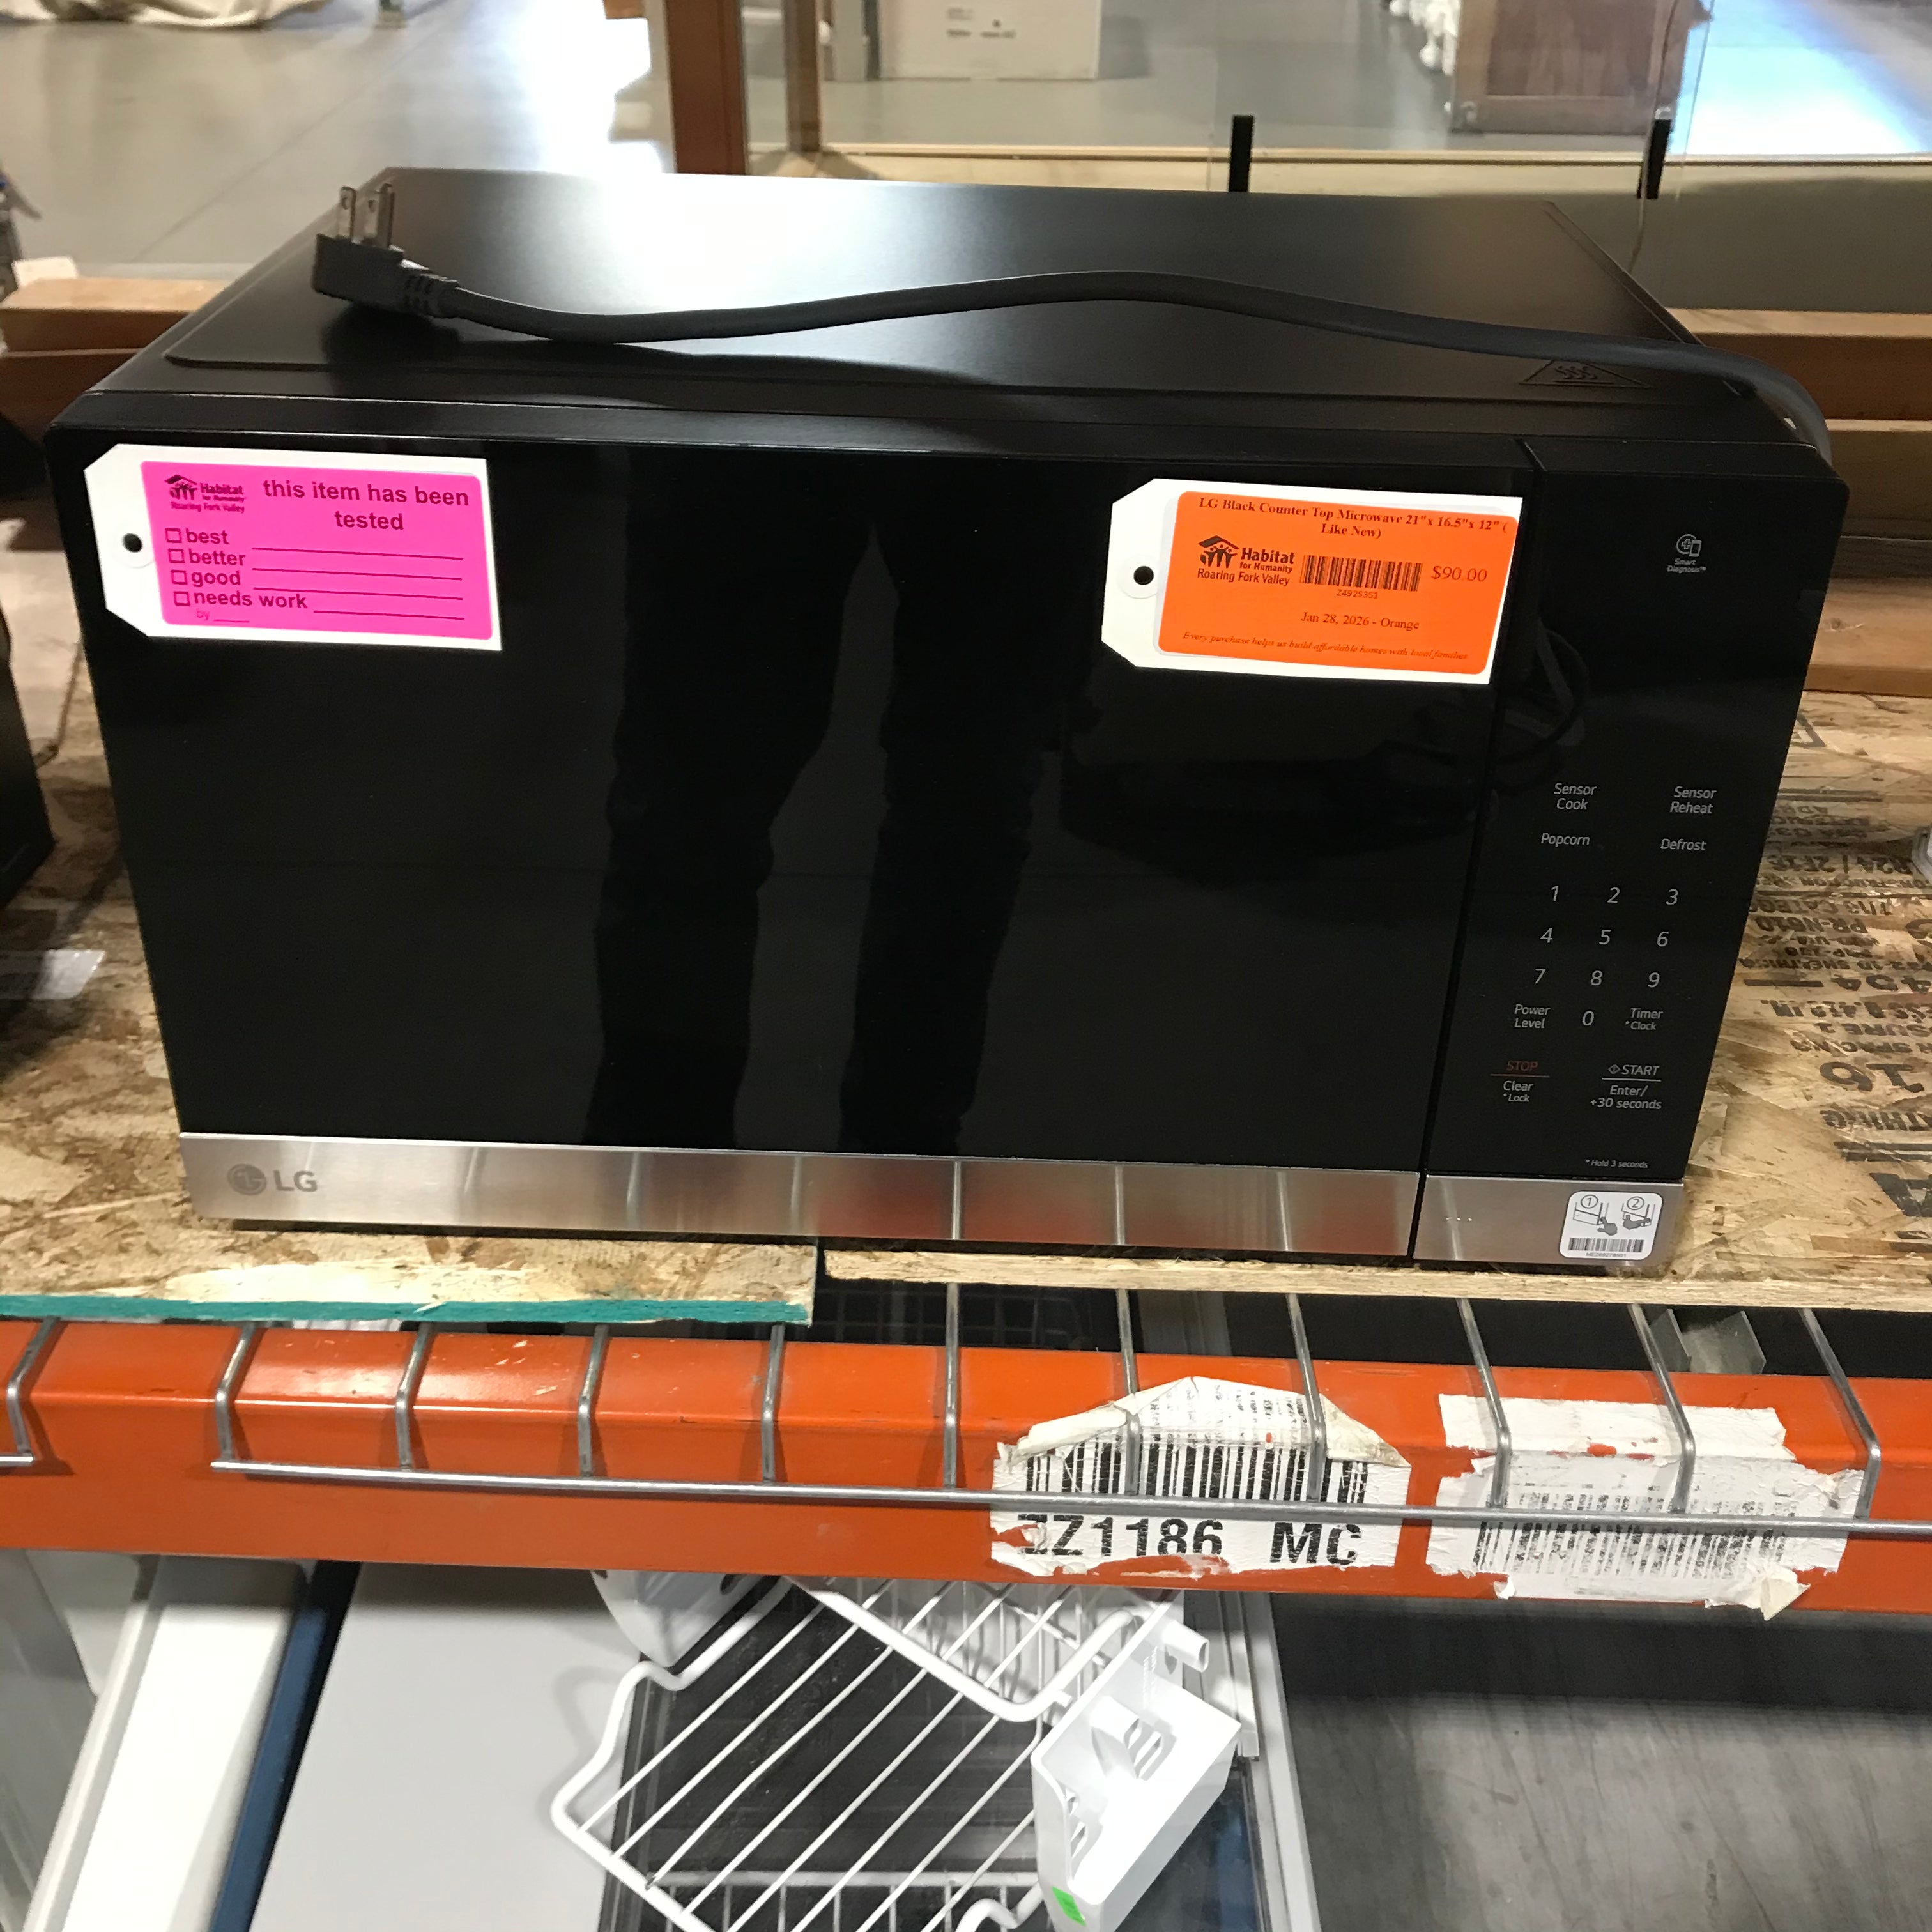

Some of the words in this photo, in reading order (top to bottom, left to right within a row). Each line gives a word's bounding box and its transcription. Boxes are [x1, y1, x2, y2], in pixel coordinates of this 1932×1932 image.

[263, 480, 305, 498] this
[312, 482, 360, 500] item
[367, 484, 407, 503] has
[415, 486, 469, 506] been
[1199, 498, 1218, 509] LG
[1223, 500, 1256, 512] Black
[1260, 502, 1308, 516] Counter
[1312, 507, 1334, 521] Top
[1338, 509, 1403, 524] Microwave
[335, 511, 404, 530] tested
[185, 528, 229, 545] best
[1321, 523, 1347, 535] Like
[1351, 525, 1381, 539] New)
[189, 548, 246, 566] better
[1241, 547, 1296, 565] Habitat
[1240, 561, 1252, 569] for
[1254, 564, 1292, 574] Humanity
[1431, 565, 1488, 583] $90.00
[192, 570, 241, 588] good
[1197, 568, 1235, 583] Roaring
[1238, 571, 1259, 583] Fork
[1262, 574, 1290, 587] Valley
[194, 590, 253, 606] needs
[259, 594, 308, 609] work
[197, 609, 210, 621] by
[1301, 611, 1319, 623] Jan
[1322, 613, 1338, 625] 28,
[1342, 615, 1370, 626] 2026
[1380, 617, 1420, 631] Orange
[1183, 631, 1208, 643] Every
[1210, 635, 1249, 645] purchase
[1252, 637, 1275, 648] helps
[1289, 640, 1312, 649] build
[1313, 642, 1358, 652] affordable
[1360, 645, 1387, 654] homes
[1554, 783, 1597, 795] Sensor
[1673, 786, 1717, 799] Sensor
[1556, 798, 1589, 810] Cook
[1669, 801, 1714, 814] Reheat
[1540, 832, 1591, 847] Popcorn
[1660, 838, 1707, 851] Defrost
[1551, 885, 1560, 901] 1
[1607, 887, 1621, 903] 2
[1666, 889, 1679, 905] 3
[1540, 928, 1553, 943] 4
[1598, 929, 1612, 945] 5
[1657, 931, 1669, 947] 6
[1535, 968, 1546, 984] 7
[1590, 970, 1603, 986] 8
[1648, 972, 1660, 988] 9
[1514, 1004, 1551, 1016] Power
[1630, 1008, 1664, 1019] Timer
[1514, 1017, 1546, 1029] Level
[1582, 1011, 1595, 1026] 0
[1840, 1023, 1932, 1038] SURE
[1506, 1061, 1538, 1071] STOP
[1621, 1064, 1660, 1075] START
[1819, 1061, 1924, 1093] 16
[1503, 1080, 1533, 1091] Clear
[1610, 1085, 1648, 1096] Enter/
[1590, 1098, 1614, 1108] +30
[1616, 1098, 1662, 1110] seconds
[1591, 1159, 1609, 1167] Hold
[1618, 1160, 1649, 1169] seconds
[273, 1170, 318, 1192] LG
[1270, 1522, 1362, 1565] MC
